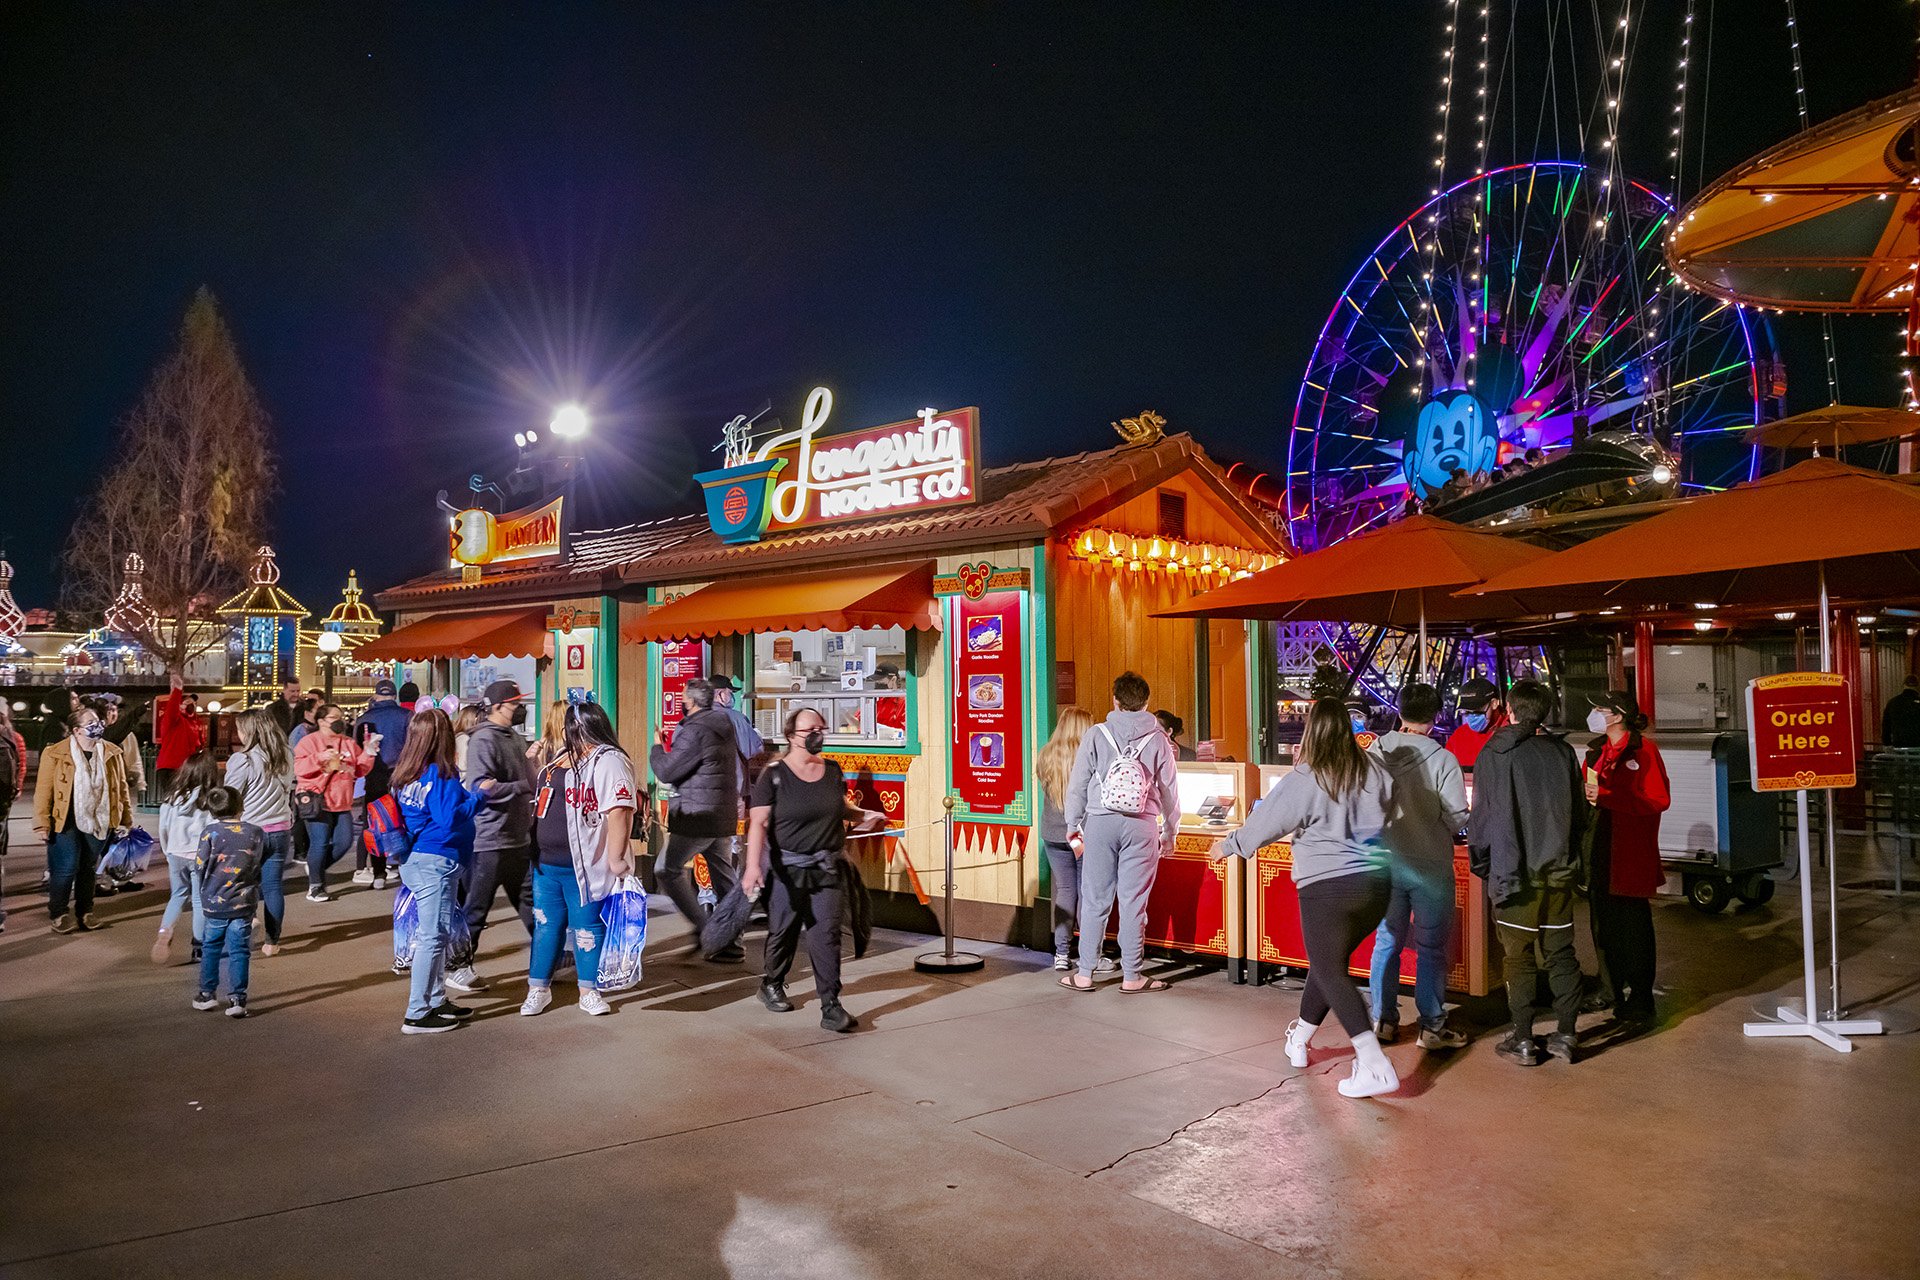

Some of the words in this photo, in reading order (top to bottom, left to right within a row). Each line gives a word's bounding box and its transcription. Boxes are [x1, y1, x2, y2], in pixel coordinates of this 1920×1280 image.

[755, 387, 966, 524] Longevity
[819, 479, 920, 518] NOODLE
[505, 509, 558, 551] LANTERN
[1760, 676, 1789, 688] LUNAR
[1771, 709, 1835, 727] Order
[1778, 733, 1830, 750] Here
